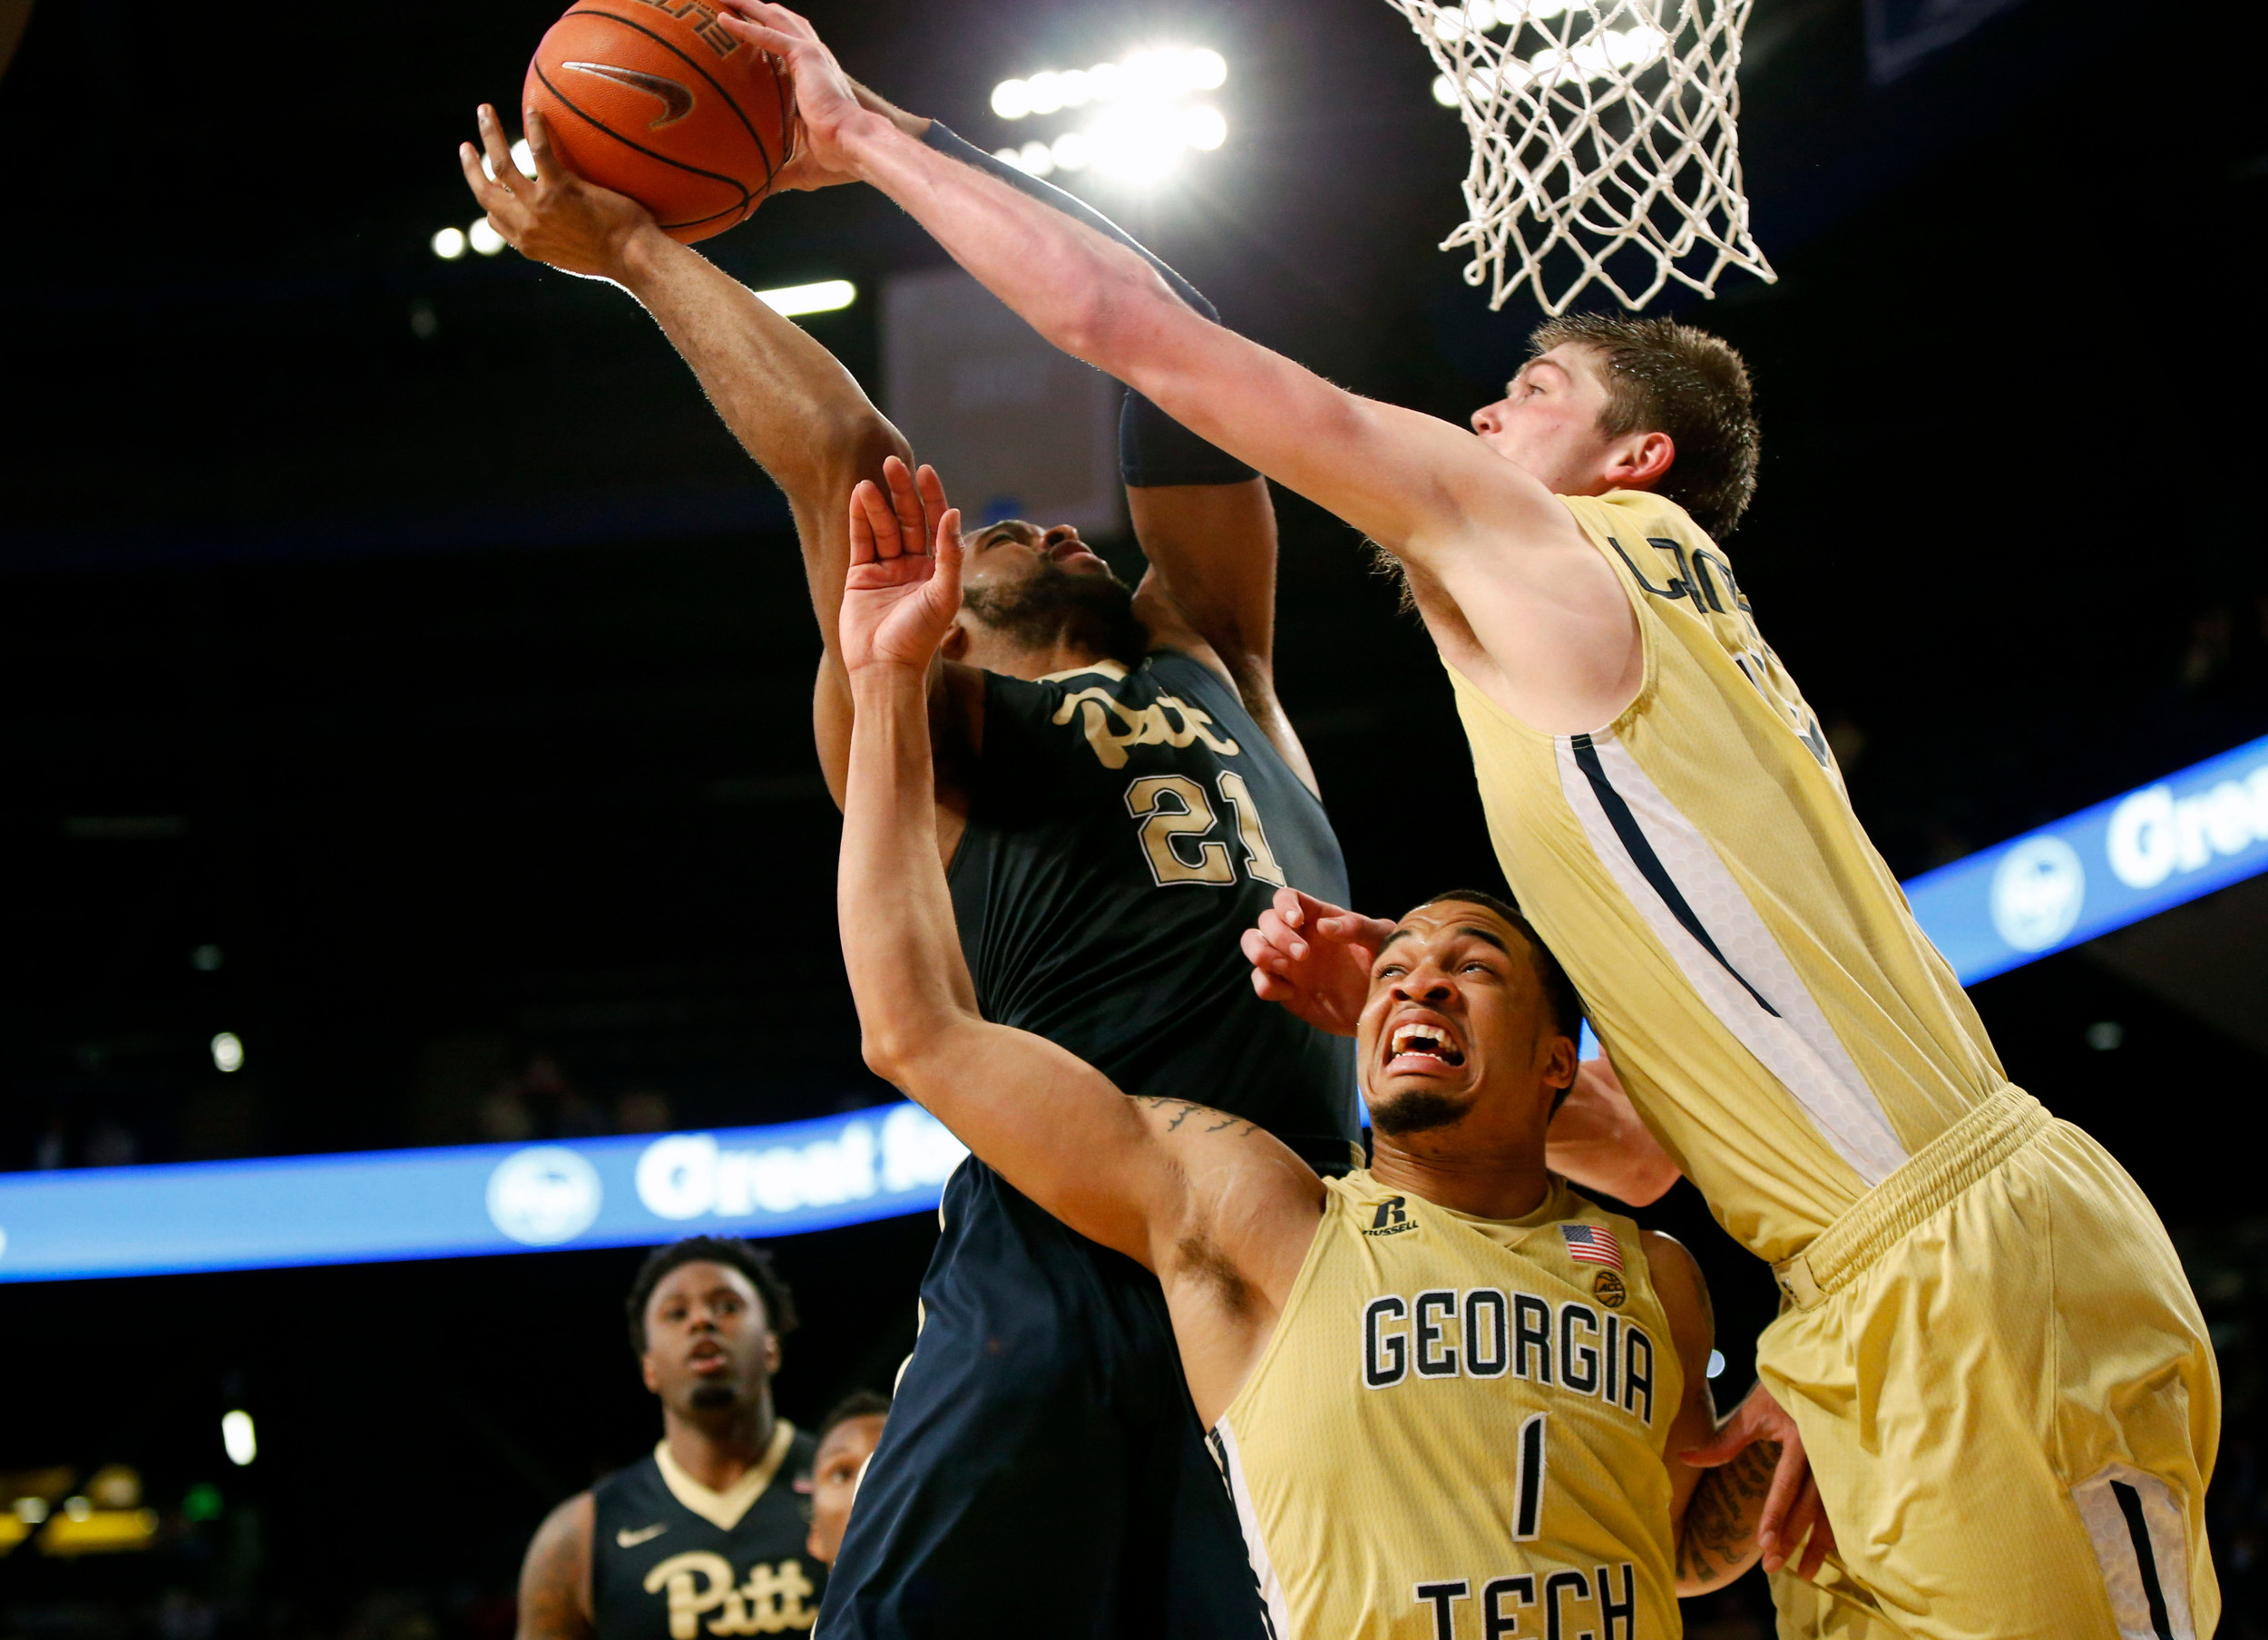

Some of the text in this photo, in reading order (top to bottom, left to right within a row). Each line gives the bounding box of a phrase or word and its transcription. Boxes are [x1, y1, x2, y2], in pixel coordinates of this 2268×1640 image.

[635, 0, 738, 57] LITE
[1124, 770, 1287, 887] 21
[1362, 1219, 1420, 1236] RUSSELL
[1364, 1287, 1654, 1429] GEORGIA
[1512, 1411, 1547, 1542] 1
[643, 1551, 819, 1640] Pitt
[1414, 1563, 1637, 1640] TECH
